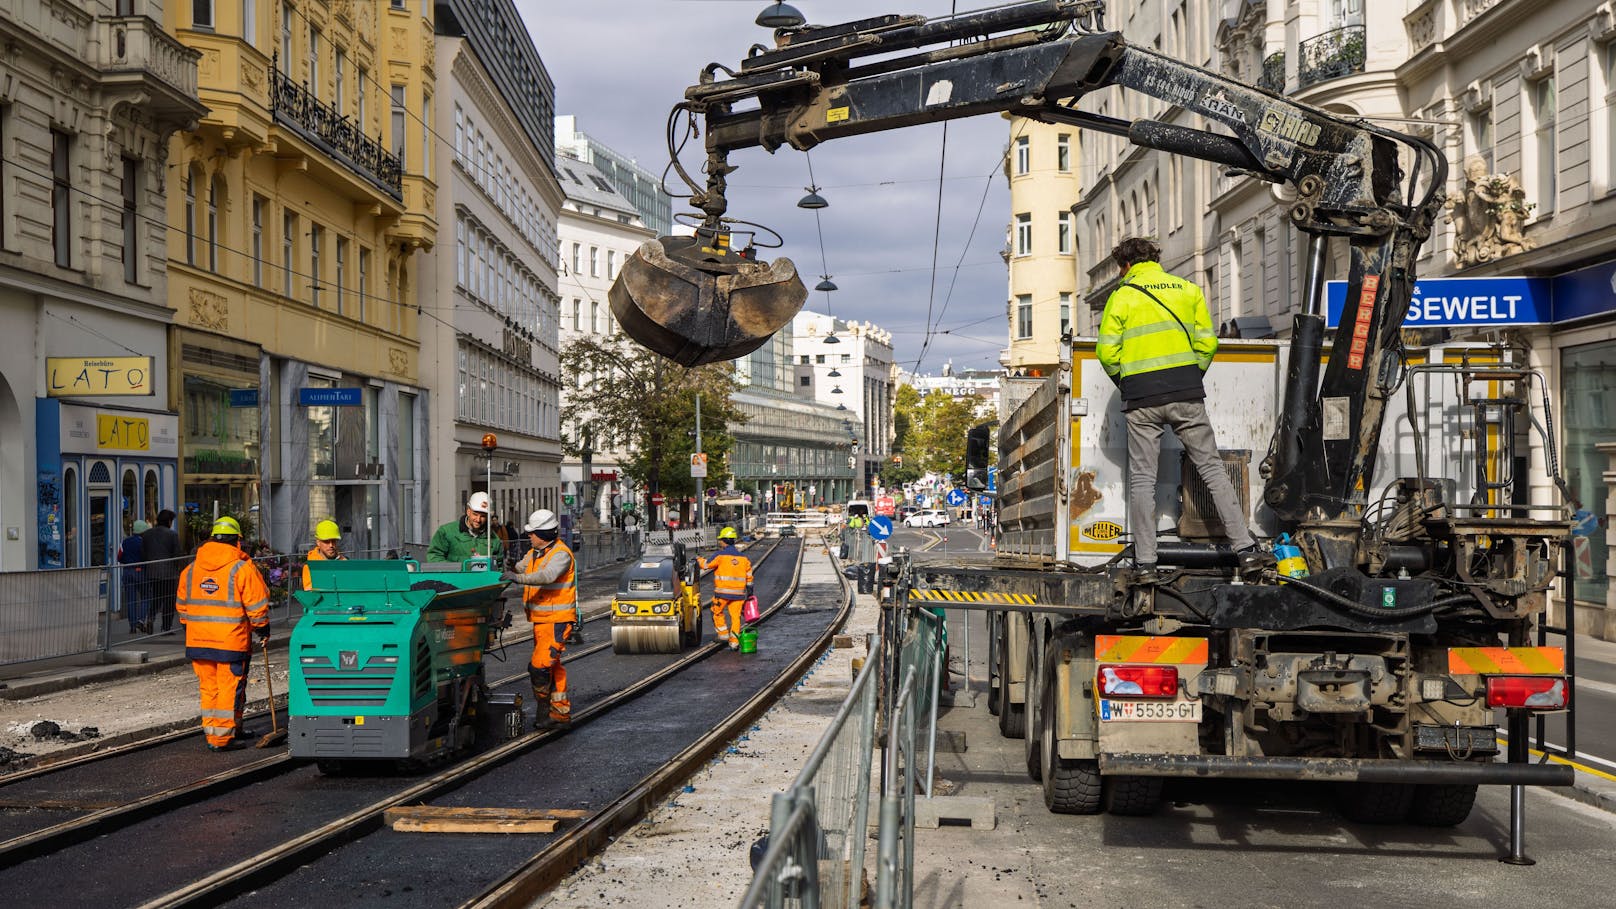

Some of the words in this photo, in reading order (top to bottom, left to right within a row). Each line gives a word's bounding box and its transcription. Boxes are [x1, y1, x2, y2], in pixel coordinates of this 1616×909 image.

[1280, 113, 1322, 147] HIAB
[1141, 282, 1183, 290] PINDLER
[1413, 286, 1421, 295] &
[1347, 275, 1380, 370] BERGER
[52, 368, 144, 389] LATO
[98, 417, 147, 448] LATO
[1084, 523, 1120, 539] MEILLER
[1113, 703, 1123, 717] W
[1136, 703, 1174, 718] 5535
[1178, 703, 1196, 718] GT
